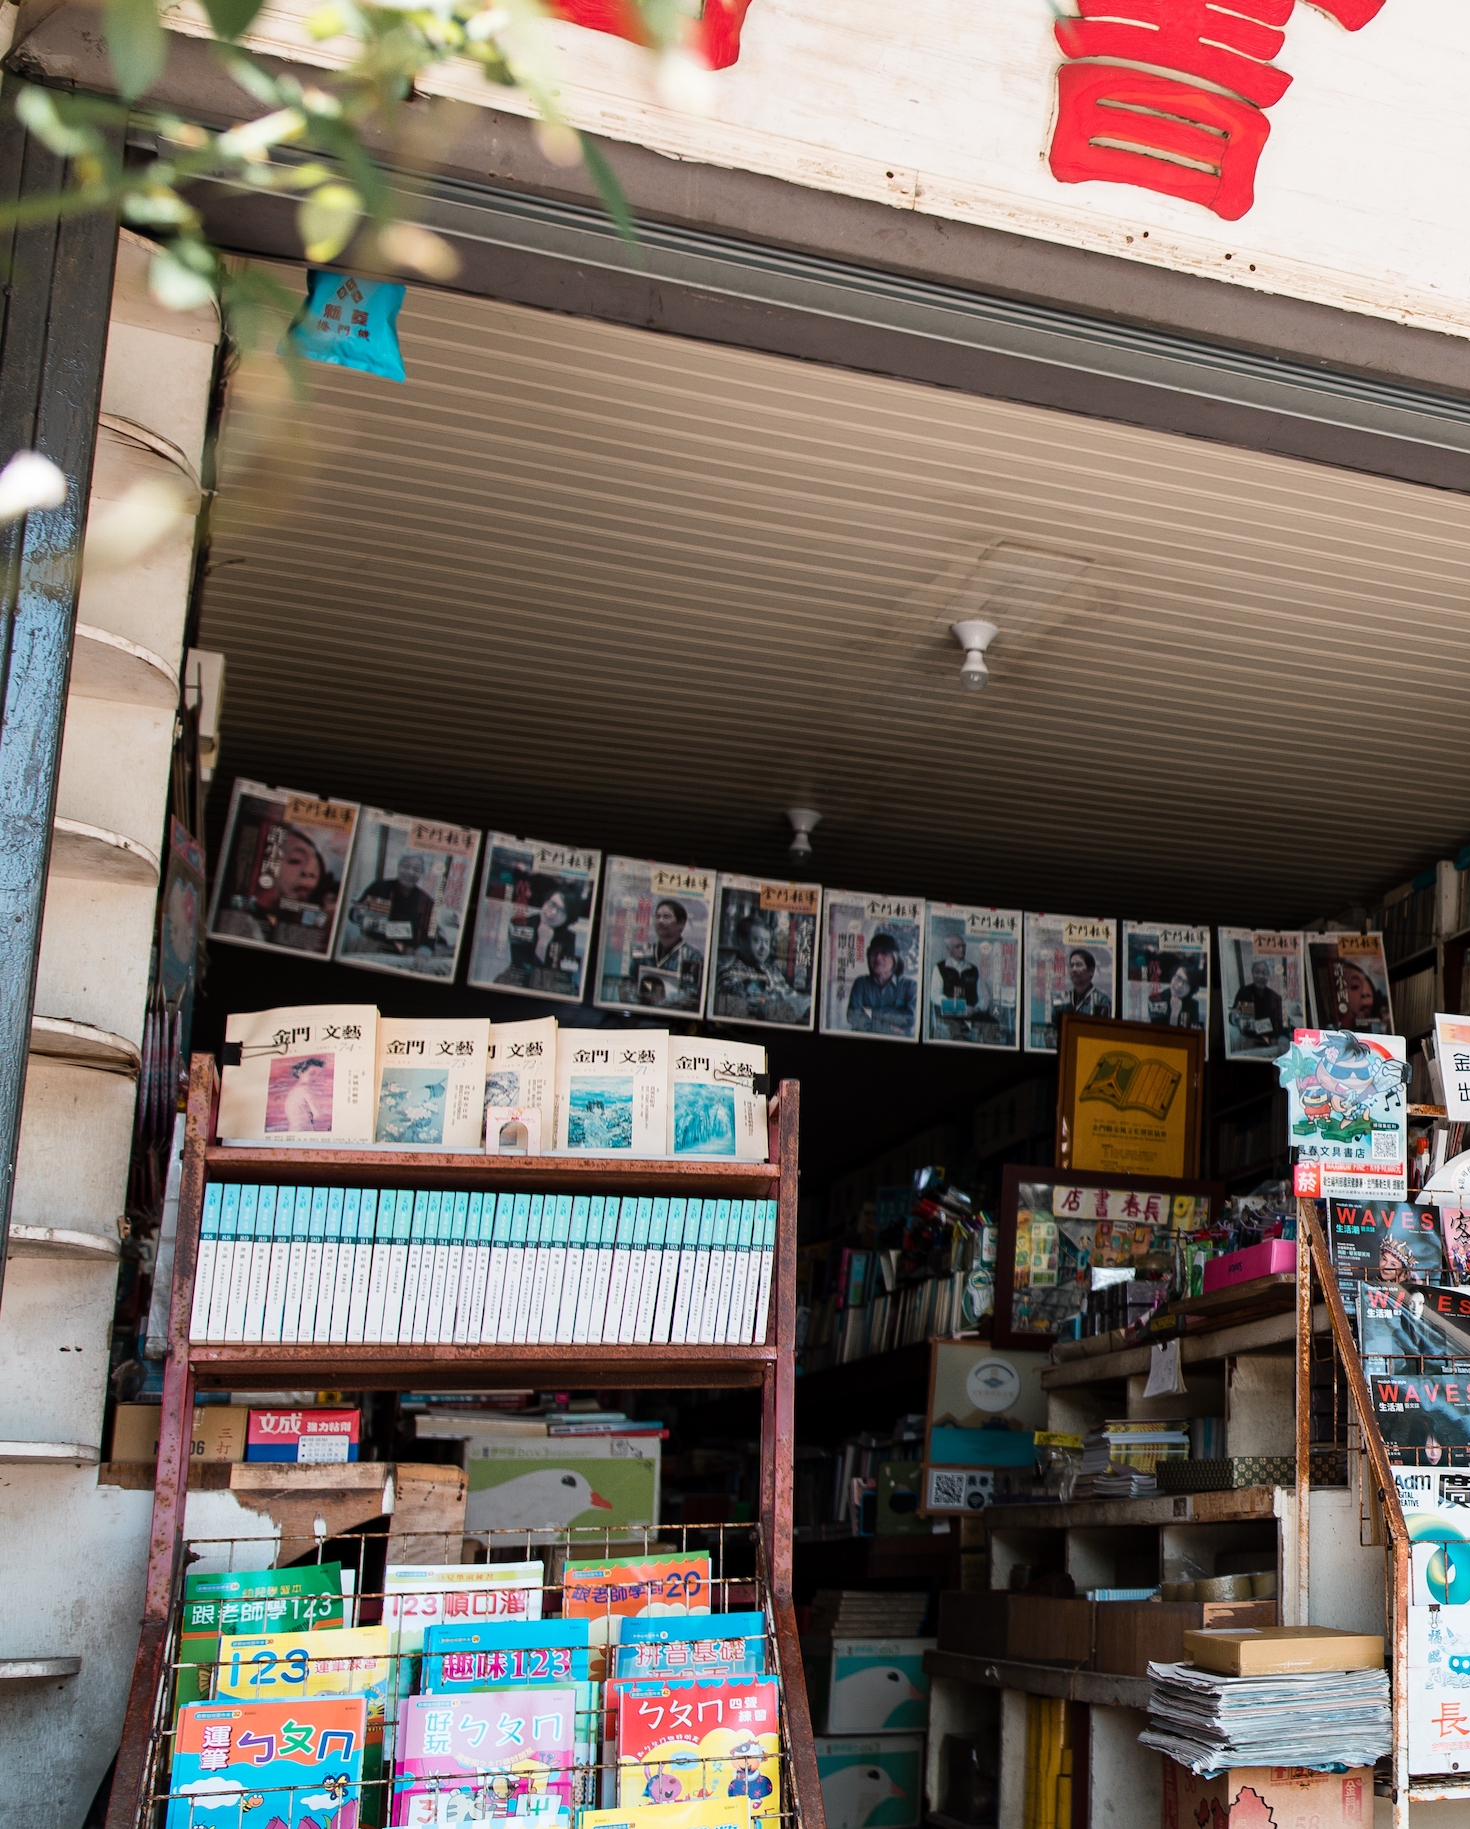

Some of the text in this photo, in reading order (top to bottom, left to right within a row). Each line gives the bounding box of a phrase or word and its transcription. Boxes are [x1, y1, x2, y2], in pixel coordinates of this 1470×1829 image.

[272, 1024, 362, 1046] 金門 文藝
[386, 1040, 475, 1056] 金門 文藝
[506, 1041, 544, 1058] 文藝
[573, 1050, 656, 1065] 金門 文藝
[675, 1056, 710, 1071] 金門
[1298, 1145, 1366, 1159] 長春文具書店
[1336, 1207, 1434, 1231] WAVES
[258, 1412, 302, 1435] 文成
[425, 1711, 452, 1754] 好玩
[202, 1725, 232, 1771] 運筆
